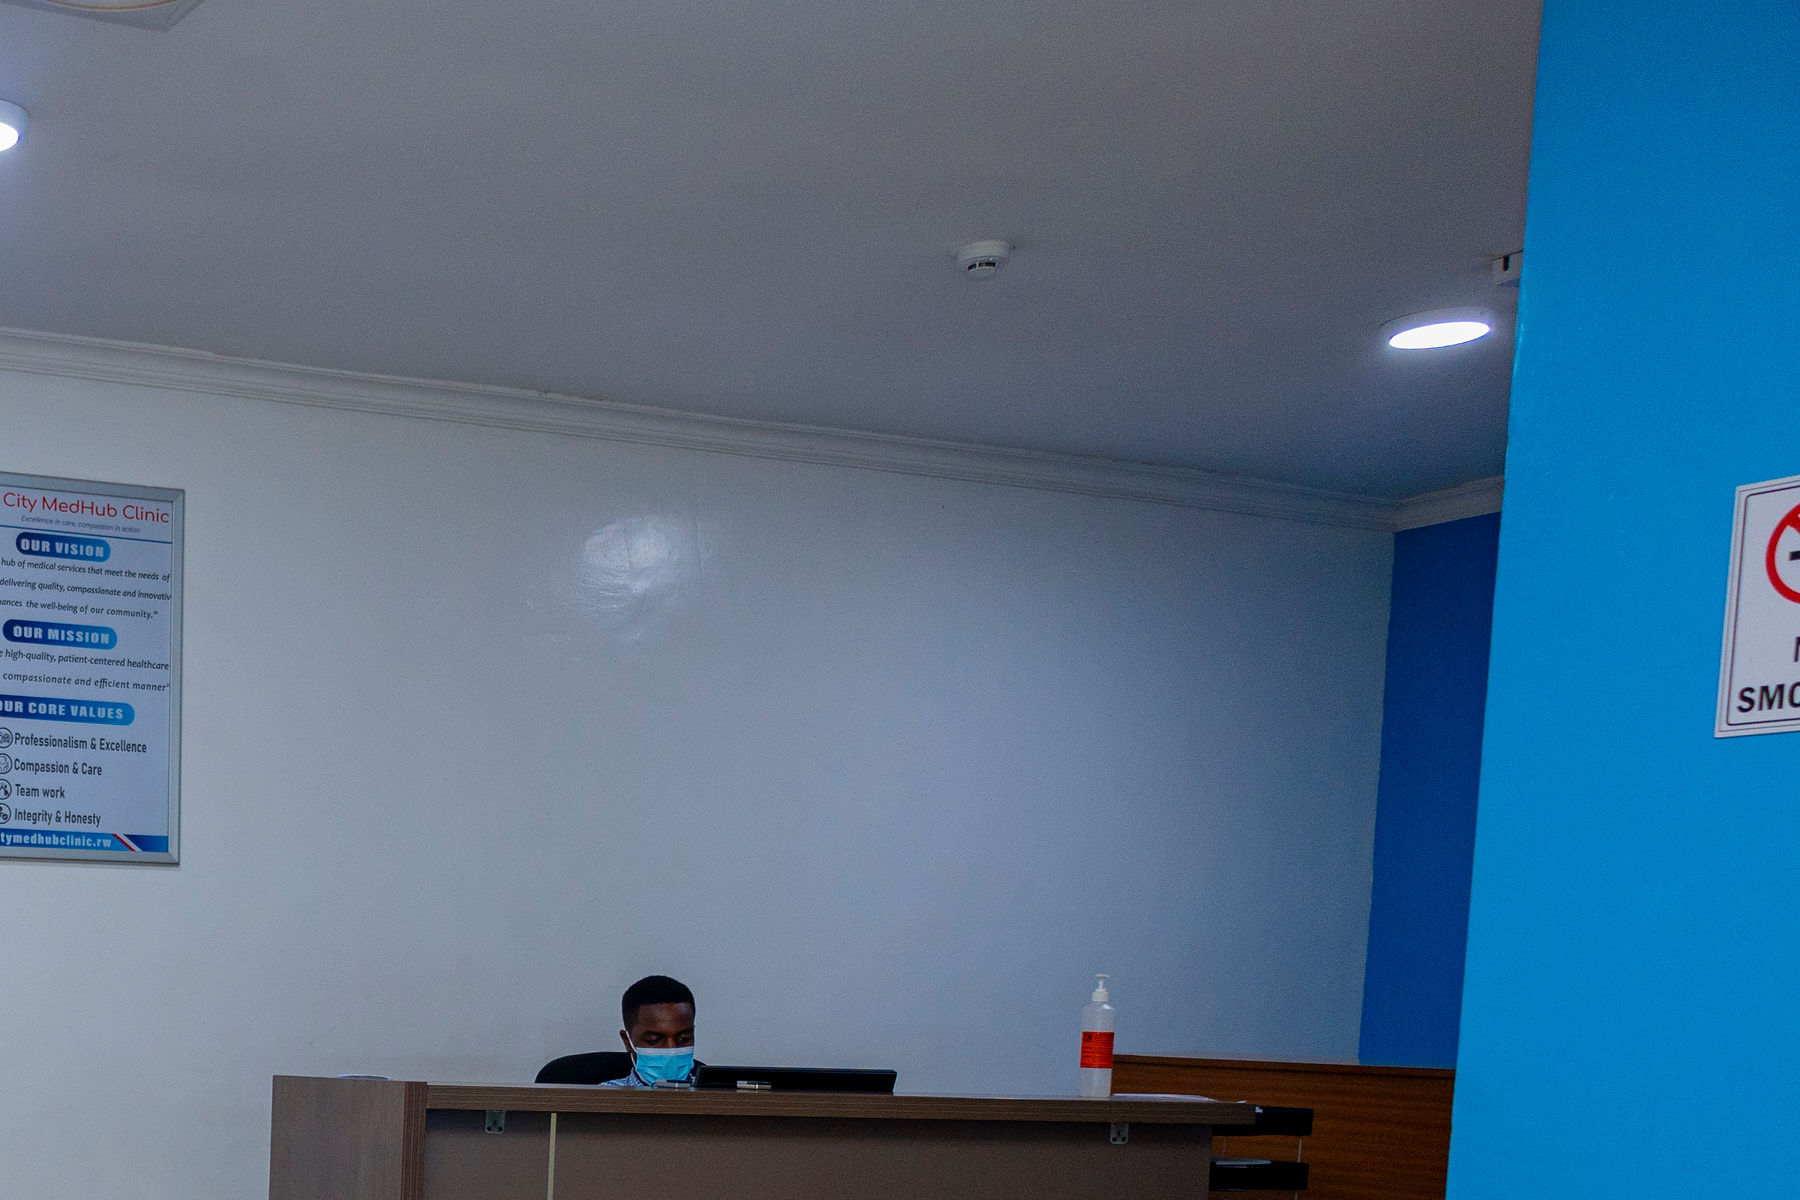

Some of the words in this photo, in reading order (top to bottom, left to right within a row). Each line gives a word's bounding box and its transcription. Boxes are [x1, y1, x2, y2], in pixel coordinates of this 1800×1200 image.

[3, 492, 38, 512] City
[42, 496, 118, 518] MedHub
[122, 504, 170, 523] Clinic
[21, 539, 50, 553] OUR
[55, 542, 104, 557] VISION
[1, 558, 16, 567] hub
[17, 559, 26, 569] of
[27, 561, 56, 571] medical
[57, 563, 86, 574] services
[88, 566, 103, 576] that
[104, 568, 123, 577] meet
[125, 569, 137, 578] the
[138, 572, 159, 581] needs
[162, 573, 171, 583] of
[0, 578, 37, 591] delivering
[38, 582, 65, 593] quality,
[67, 585, 121, 597] compassionate
[122, 590, 137, 598] and
[26, 600, 39, 609] the
[40, 602, 78, 614] well-being
[79, 605, 88, 614] of
[13, 626, 42, 639] OUR
[47, 629, 109, 644] MISSION
[5, 649, 56, 664] high-quality,
[57, 655, 126, 667] patient-centered
[127, 659, 169, 670] healthcare
[3, 673, 72, 684] compassionate
[74, 677, 92, 686] and
[94, 678, 130, 689] efficient
[28, 702, 66, 716] CORE
[70, 705, 124, 720] VALUES
[14, 732, 87, 749] Professionalism
[90, 738, 97, 750] &
[100, 738, 147, 753] Excellence
[14, 759, 69, 775] Compassion
[72, 762, 79, 774] &
[81, 763, 103, 775] Care
[15, 783, 40, 798] Team
[42, 786, 65, 799] work
[14, 808, 52, 825] Integrity
[55, 810, 62, 822] &
[64, 811, 101, 827] Honesty
